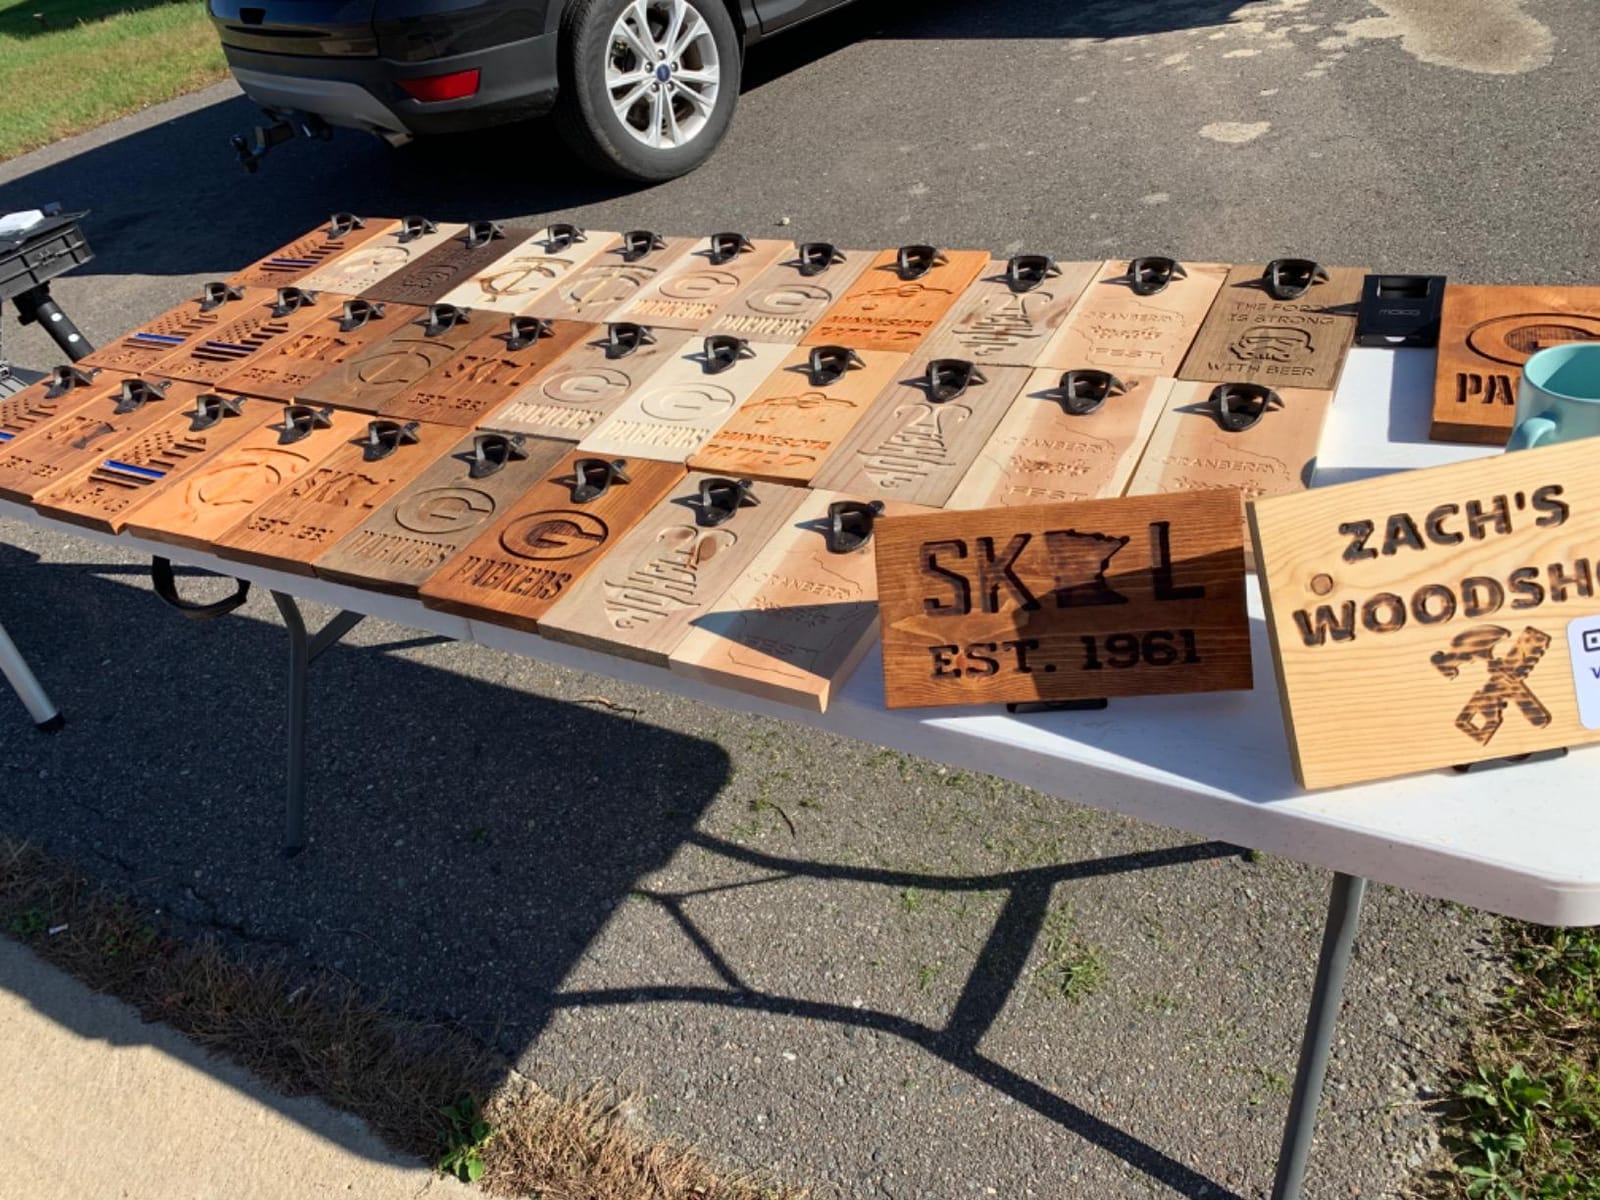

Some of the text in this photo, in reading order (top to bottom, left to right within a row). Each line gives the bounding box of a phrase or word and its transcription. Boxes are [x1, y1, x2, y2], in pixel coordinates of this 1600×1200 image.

[1254, 313, 1335, 325] STRONG
[1208, 362, 1315, 376] WITH BEER
[1338, 484, 1570, 564] ZACH'S
[449, 555, 573, 600] PACKERS
[1292, 557, 1600, 648] WOODSH
[928, 628, 1201, 680] EST. 1961
